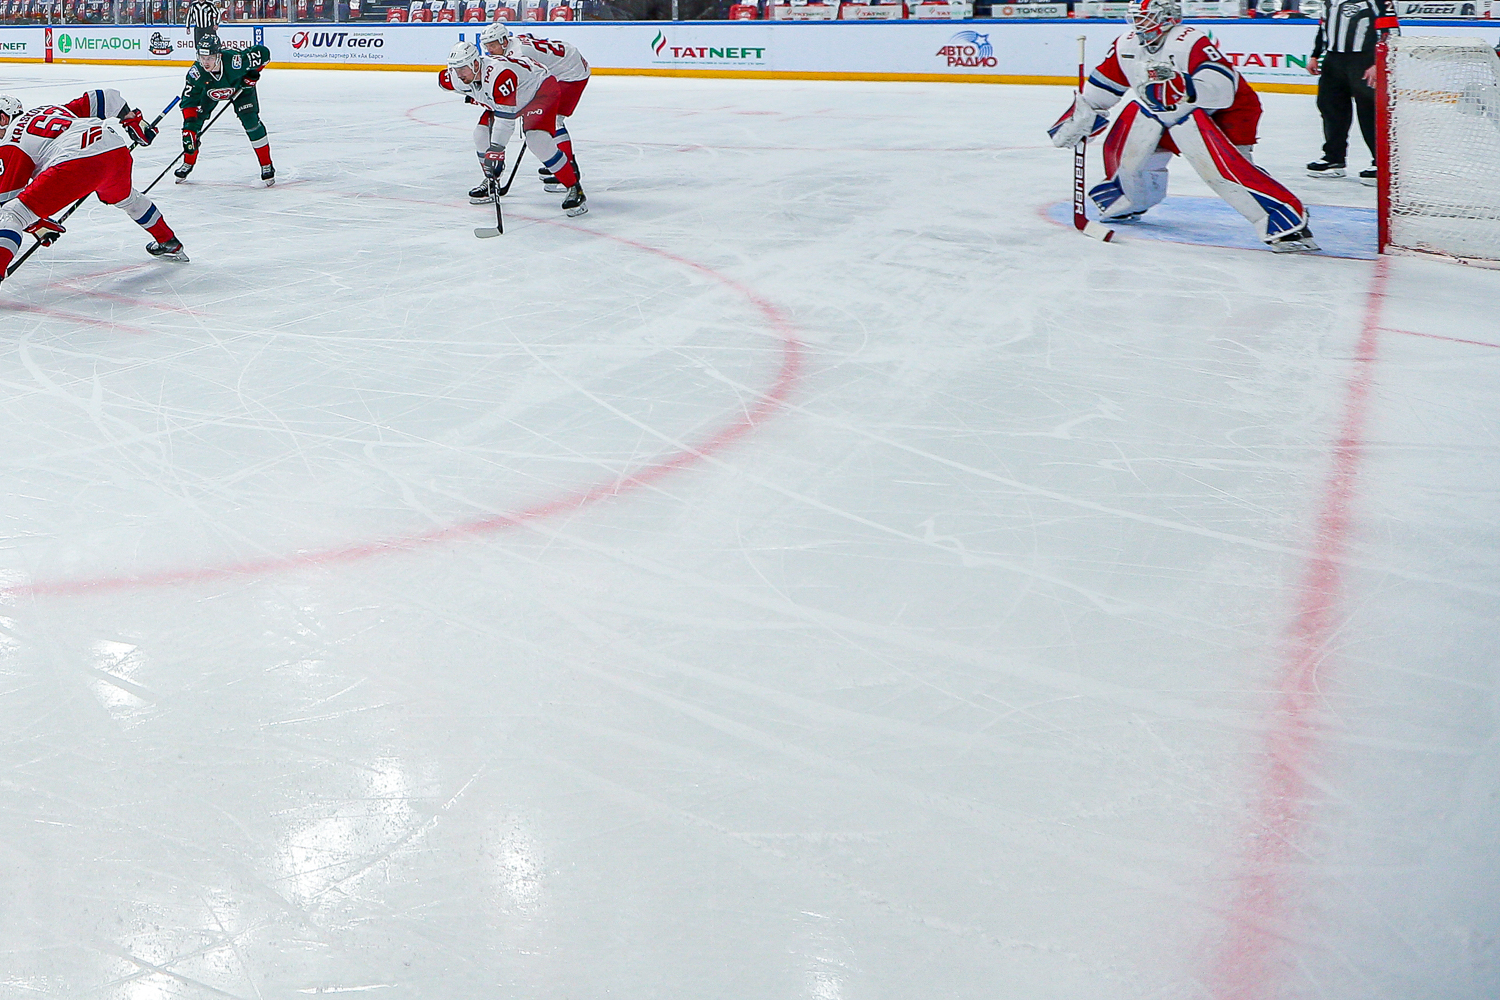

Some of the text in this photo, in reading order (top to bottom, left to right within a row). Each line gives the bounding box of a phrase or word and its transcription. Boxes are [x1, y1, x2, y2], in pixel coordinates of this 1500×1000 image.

[312, 32, 384, 48] UVT aero
[292, 51, 328, 60] Официальный
[670, 47, 766, 59] TATNEFT
[936, 45, 976, 57] АВТО
[947, 57, 998, 67] РАДИО
[1225, 52, 1324, 68] TATN
[498, 78, 516, 97] 87
